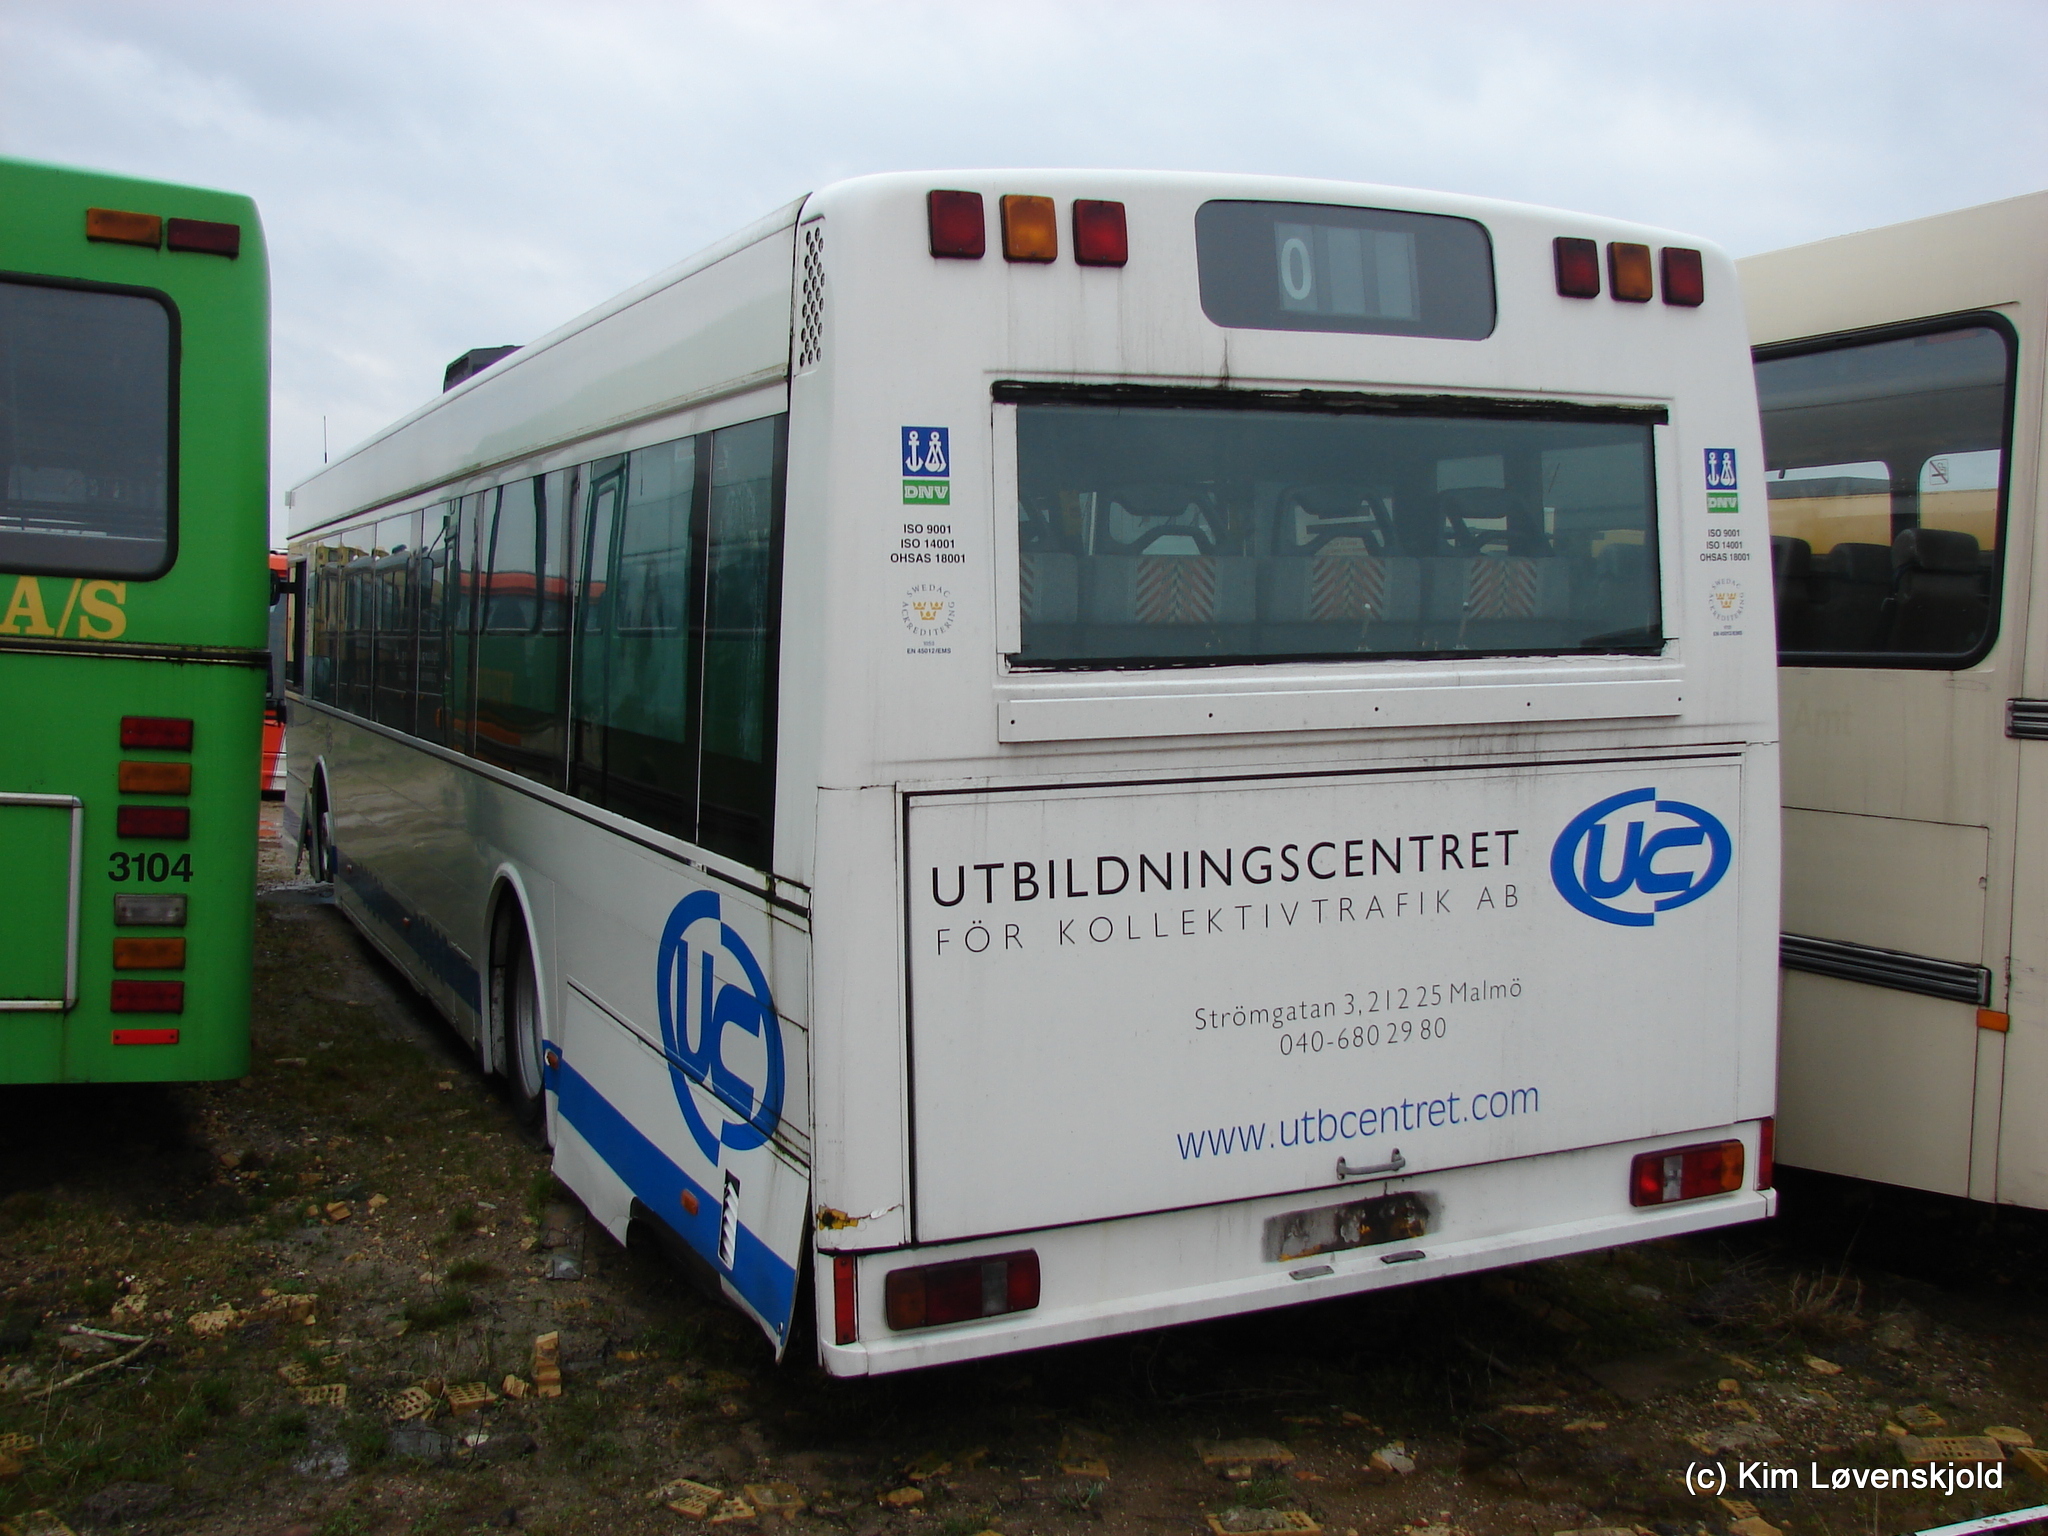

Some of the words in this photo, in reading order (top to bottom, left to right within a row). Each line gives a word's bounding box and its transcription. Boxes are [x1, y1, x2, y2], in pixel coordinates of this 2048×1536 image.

[1281, 238, 1312, 300] 0
[904, 485, 949, 499] DNV
[1707, 497, 1737, 508] DNV
[903, 524, 923, 534] ISO
[926, 524, 952, 534] 9001
[1708, 529, 1721, 537] ISO
[1723, 529, 1740, 537] 9001
[900, 539, 920, 548] ISO
[924, 539, 955, 549] 14001
[1706, 541, 1720, 549] ISO
[1722, 541, 1743, 549] 14001
[890, 553, 931, 563] OHSAS
[935, 553, 966, 563] 18001
[1700, 553, 1728, 562] OHSAS
[906, 584, 951, 598] SWEDAC
[0, 575, 127, 640] A/S
[901, 601, 955, 636] ACKREDITERING
[108, 852, 194, 882] 3104
[932, 829, 1520, 908] UTBILDNINGSCENTRET
[938, 919, 1024, 956] FÖR
[1060, 889, 1451, 945] KOLLEKTIVTRAFIK
[1477, 884, 1519, 911] AB
[1195, 1000, 1336, 1031] Strömgatan
[1450, 978, 1522, 1005] Malmö
[1280, 1024, 1380, 1056] 040-680
[1387, 1020, 1413, 1045] 29
[1421, 1017, 1446, 1041] 80
[1177, 1087, 1540, 1161] www.utbcentret.com
